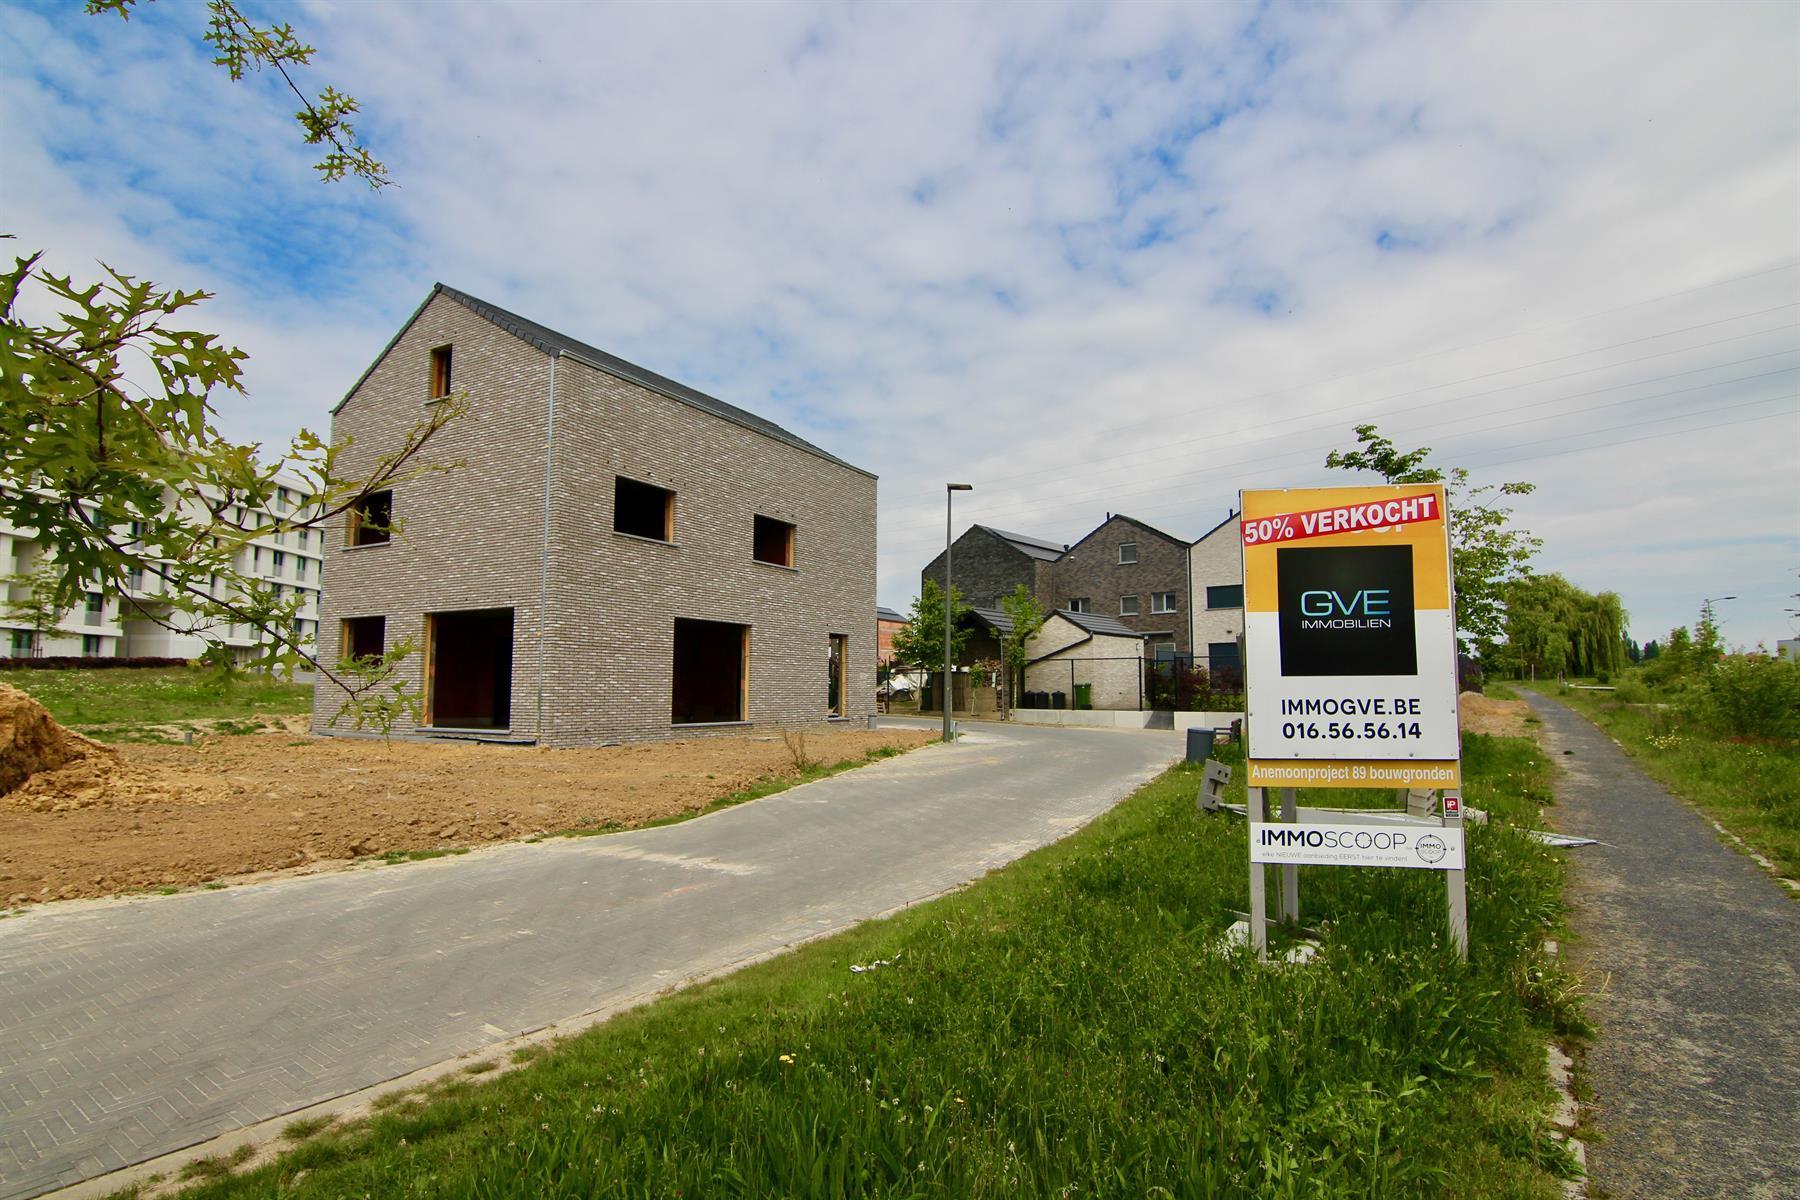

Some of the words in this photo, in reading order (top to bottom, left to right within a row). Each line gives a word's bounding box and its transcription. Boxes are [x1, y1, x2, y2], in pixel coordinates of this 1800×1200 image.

[1244, 516, 1294, 543] 50%
[1300, 496, 1434, 535] VERKOCHT
[1301, 590, 1390, 616] GVE
[1301, 618, 1391, 629] IMMOBILIEN
[1281, 699, 1421, 716] IMMOGVE.BE
[1282, 722, 1422, 739] 016.56.56.14
[1252, 765, 1349, 783] Anemoonproject
[1352, 766, 1366, 779] 89
[1369, 766, 1454, 783] bouwgronden
[1261, 829, 1407, 850] IMMOSCOOP
